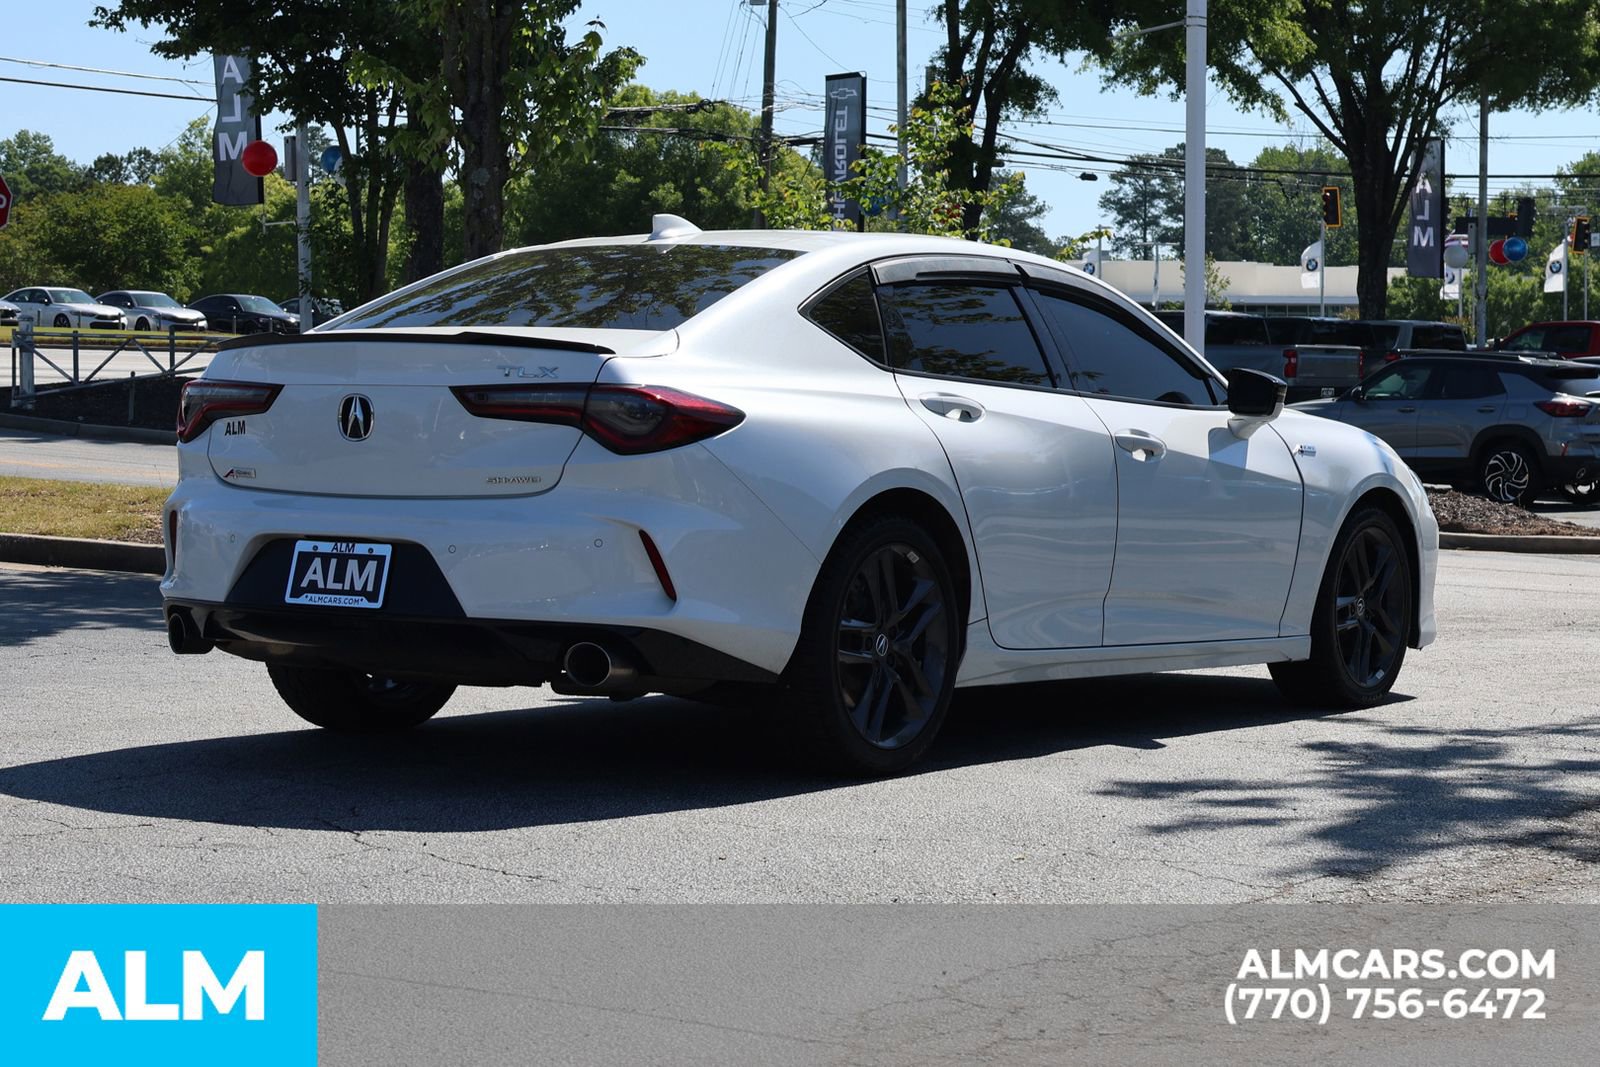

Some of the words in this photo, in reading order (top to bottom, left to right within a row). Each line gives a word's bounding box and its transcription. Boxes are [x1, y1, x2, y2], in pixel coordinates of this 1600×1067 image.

[496, 365, 559, 379] TLX
[224, 420, 246, 436] ALM
[331, 542, 356, 554] ALM
[300, 557, 378, 592] ALM
